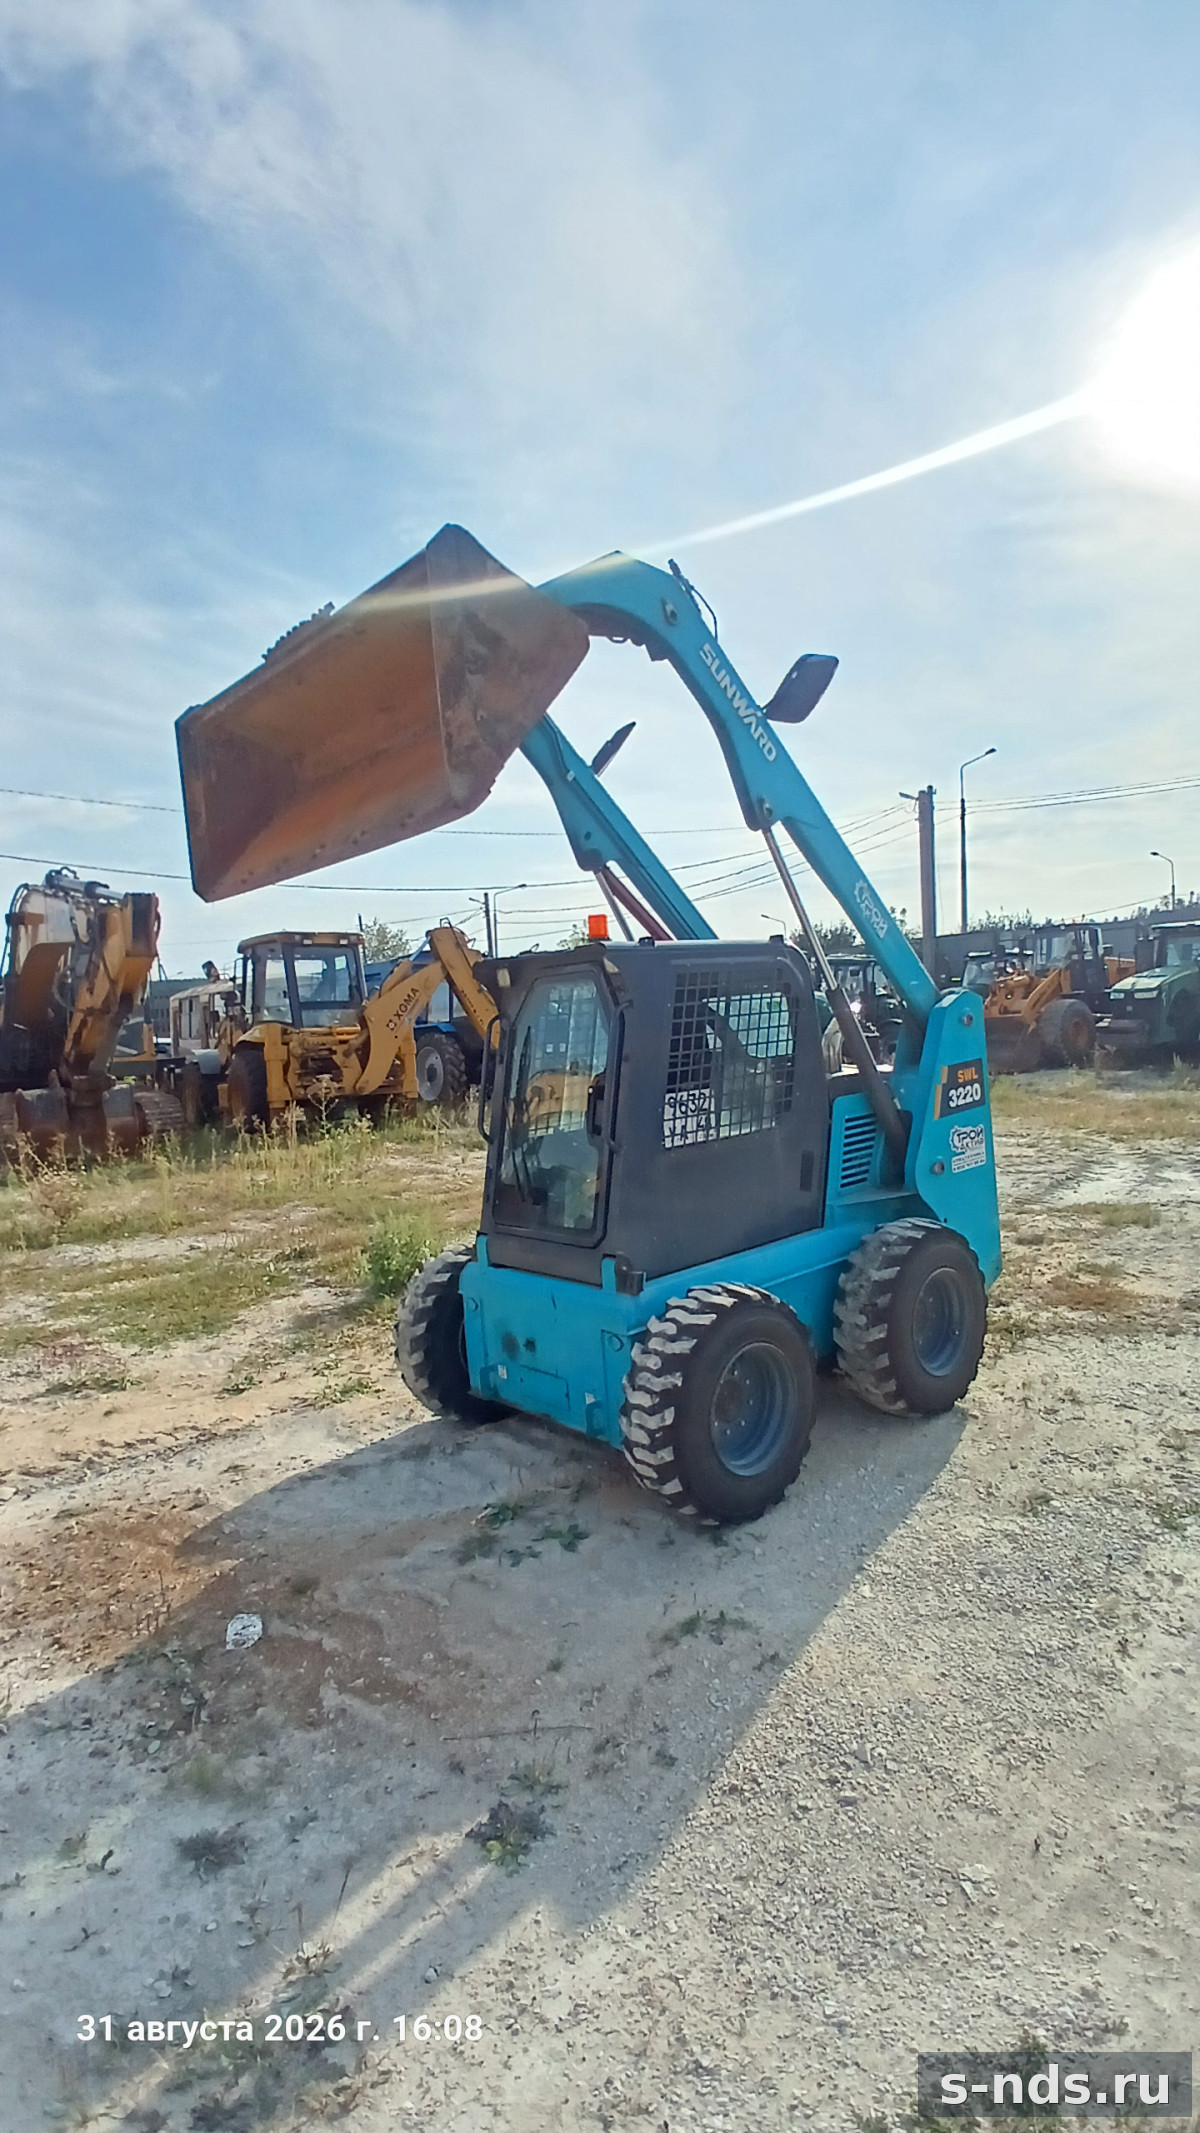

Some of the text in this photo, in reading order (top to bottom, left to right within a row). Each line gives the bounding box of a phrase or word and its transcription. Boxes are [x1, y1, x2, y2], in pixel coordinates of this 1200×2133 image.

[700, 642, 777, 762] SUNWARD
[393, 987, 420, 1021] XGMA
[957, 1066, 979, 1083] SWL
[667, 1091, 709, 1118] 9632
[948, 1082, 981, 1108] 3220
